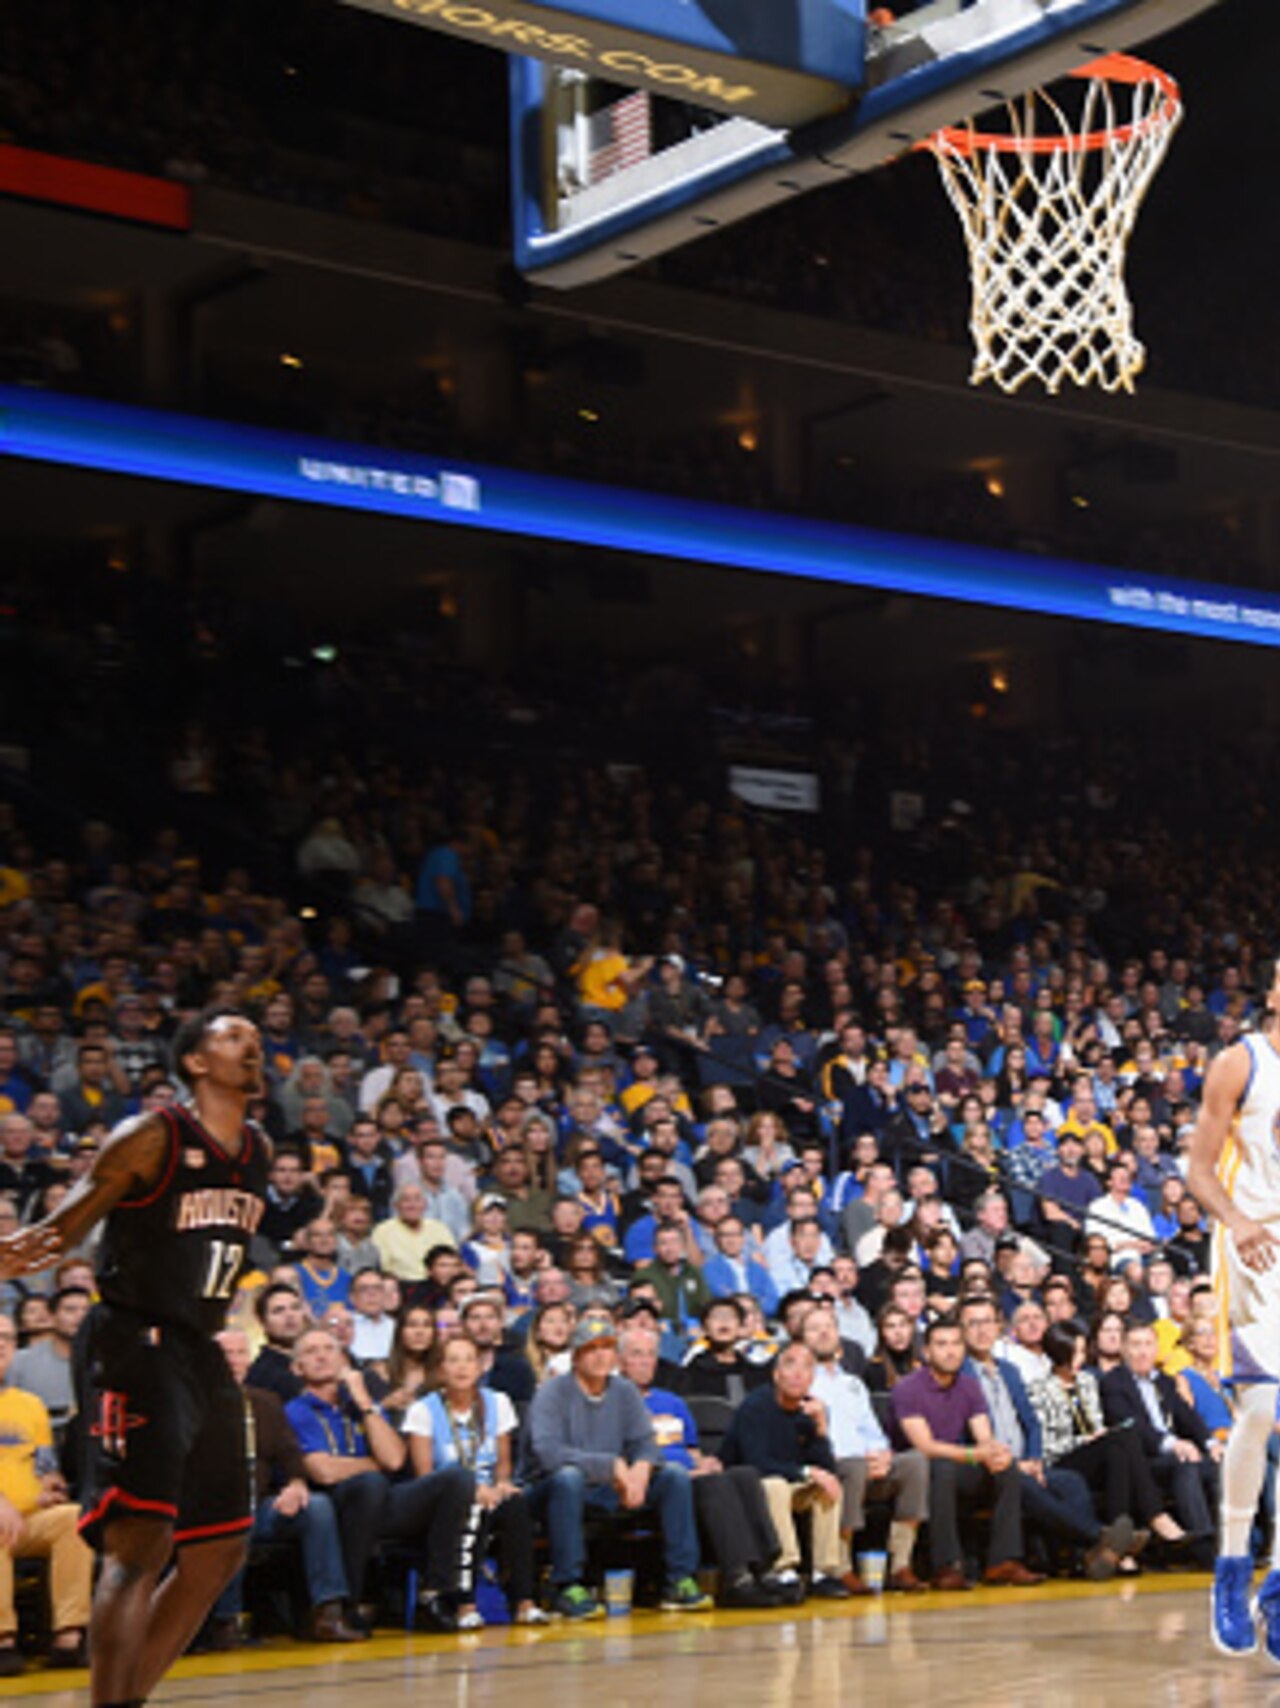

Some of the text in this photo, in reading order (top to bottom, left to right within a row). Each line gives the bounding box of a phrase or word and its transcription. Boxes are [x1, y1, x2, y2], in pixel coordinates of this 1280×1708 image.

[393, 0, 757, 102] IORS.COM
[299, 457, 438, 499] UNITED
[202, 1240, 243, 1298] 12
